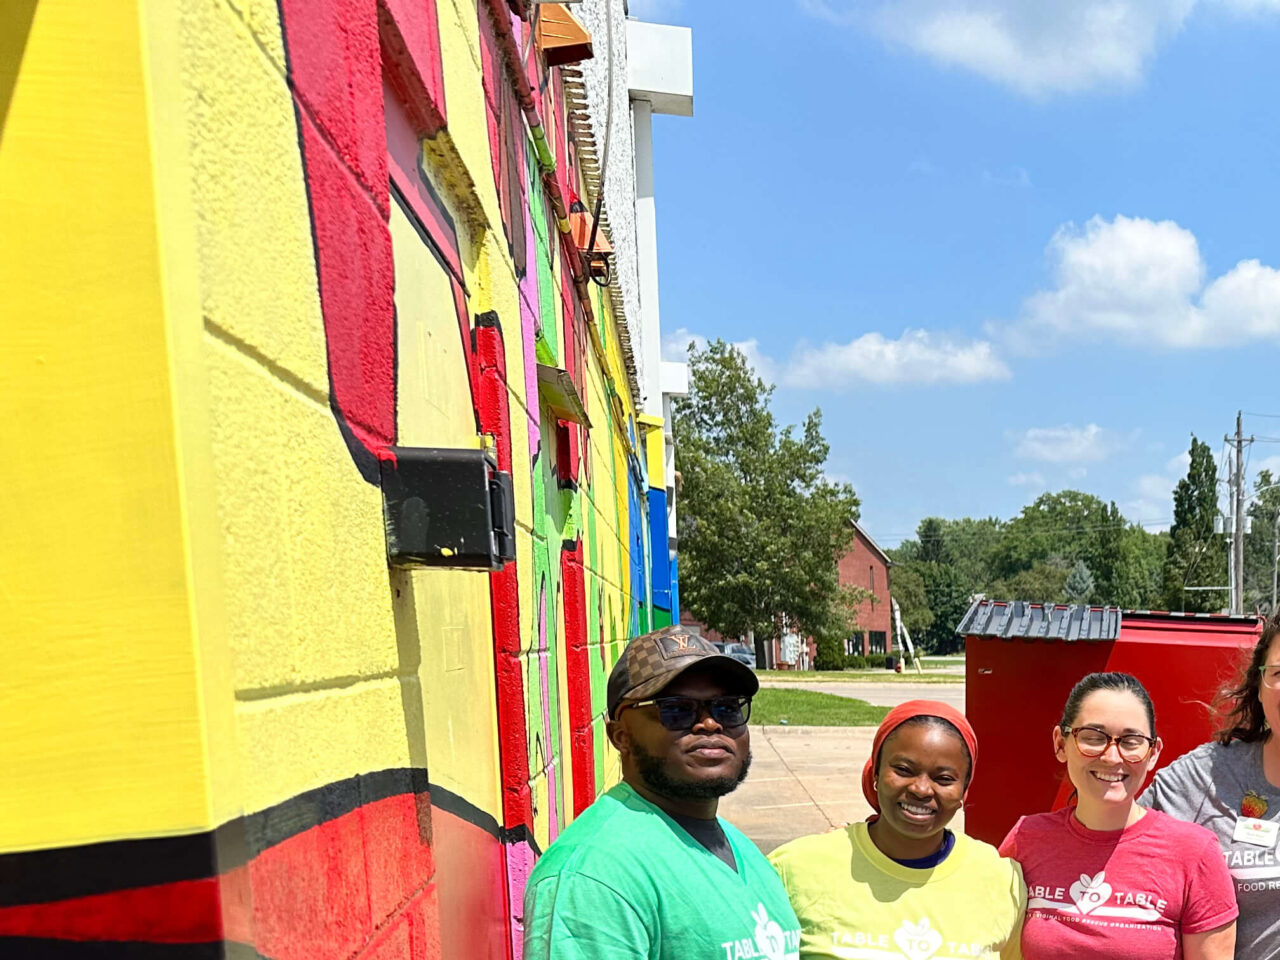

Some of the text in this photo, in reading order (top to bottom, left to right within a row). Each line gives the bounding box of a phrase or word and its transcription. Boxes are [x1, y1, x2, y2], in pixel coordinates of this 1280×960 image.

[1223, 849, 1274, 867] TABLE
[1237, 880, 1266, 893] FOOD
[1027, 885, 1168, 913] ABLE TO TABLE
[831, 932, 889, 948] TABLE
[906, 939, 930, 952] TO
